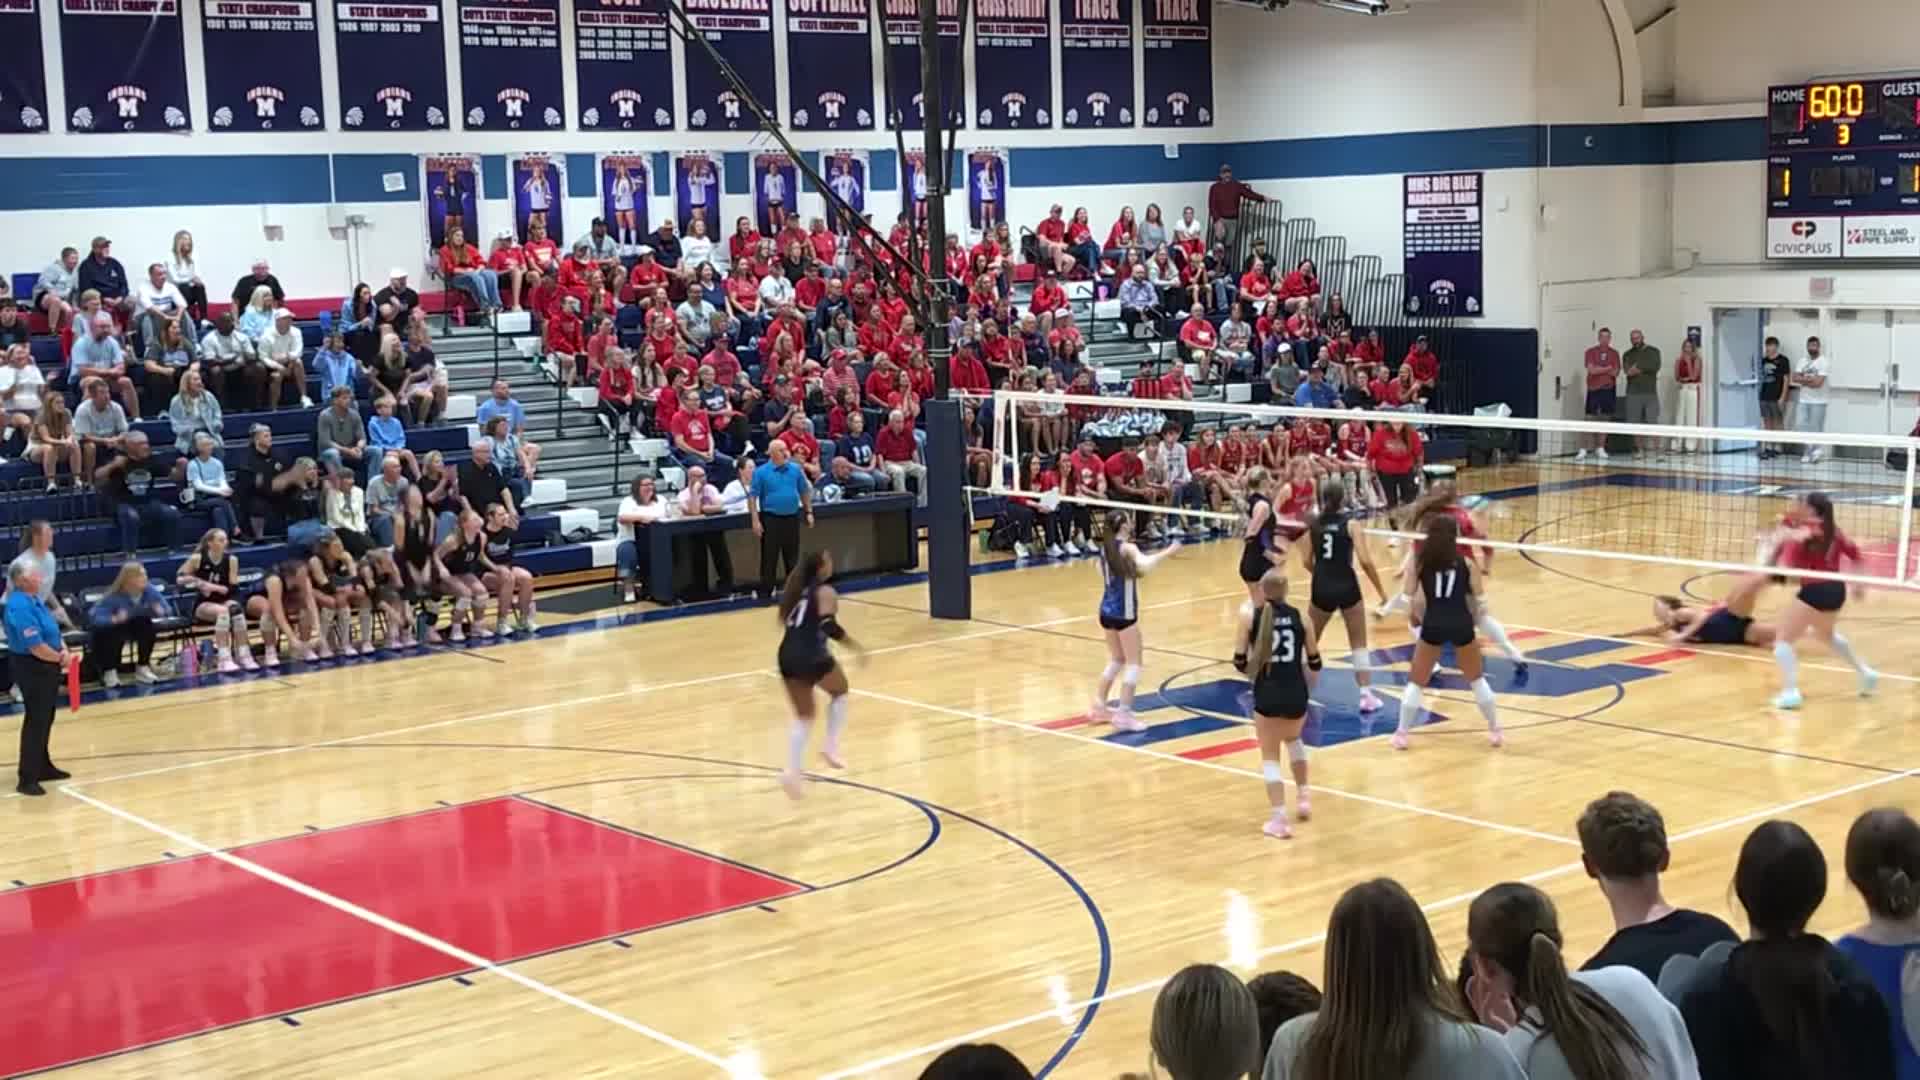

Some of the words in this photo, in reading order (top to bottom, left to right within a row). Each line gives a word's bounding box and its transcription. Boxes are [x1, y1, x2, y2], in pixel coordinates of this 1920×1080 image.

[1772, 89, 1805, 103] HOME
[118, 98, 139, 118] M
[256, 98, 276, 118] M
[385, 98, 404, 117] M
[506, 99, 523, 118] M
[618, 100, 635, 118] M
[1838, 123, 1850, 145] 3
[1408, 176, 1431, 192] MHS
[1432, 176, 1451, 192] BIG
[1452, 174, 1478, 190] BLUE
[1783, 168, 1790, 197] 1
[1863, 228, 1888, 237] STEEL
[1774, 242, 1833, 254] CIVICPLUS
[1322, 533, 1334, 560] 3
[1435, 570, 1456, 598] 17
[1271, 629, 1295, 663] 23
